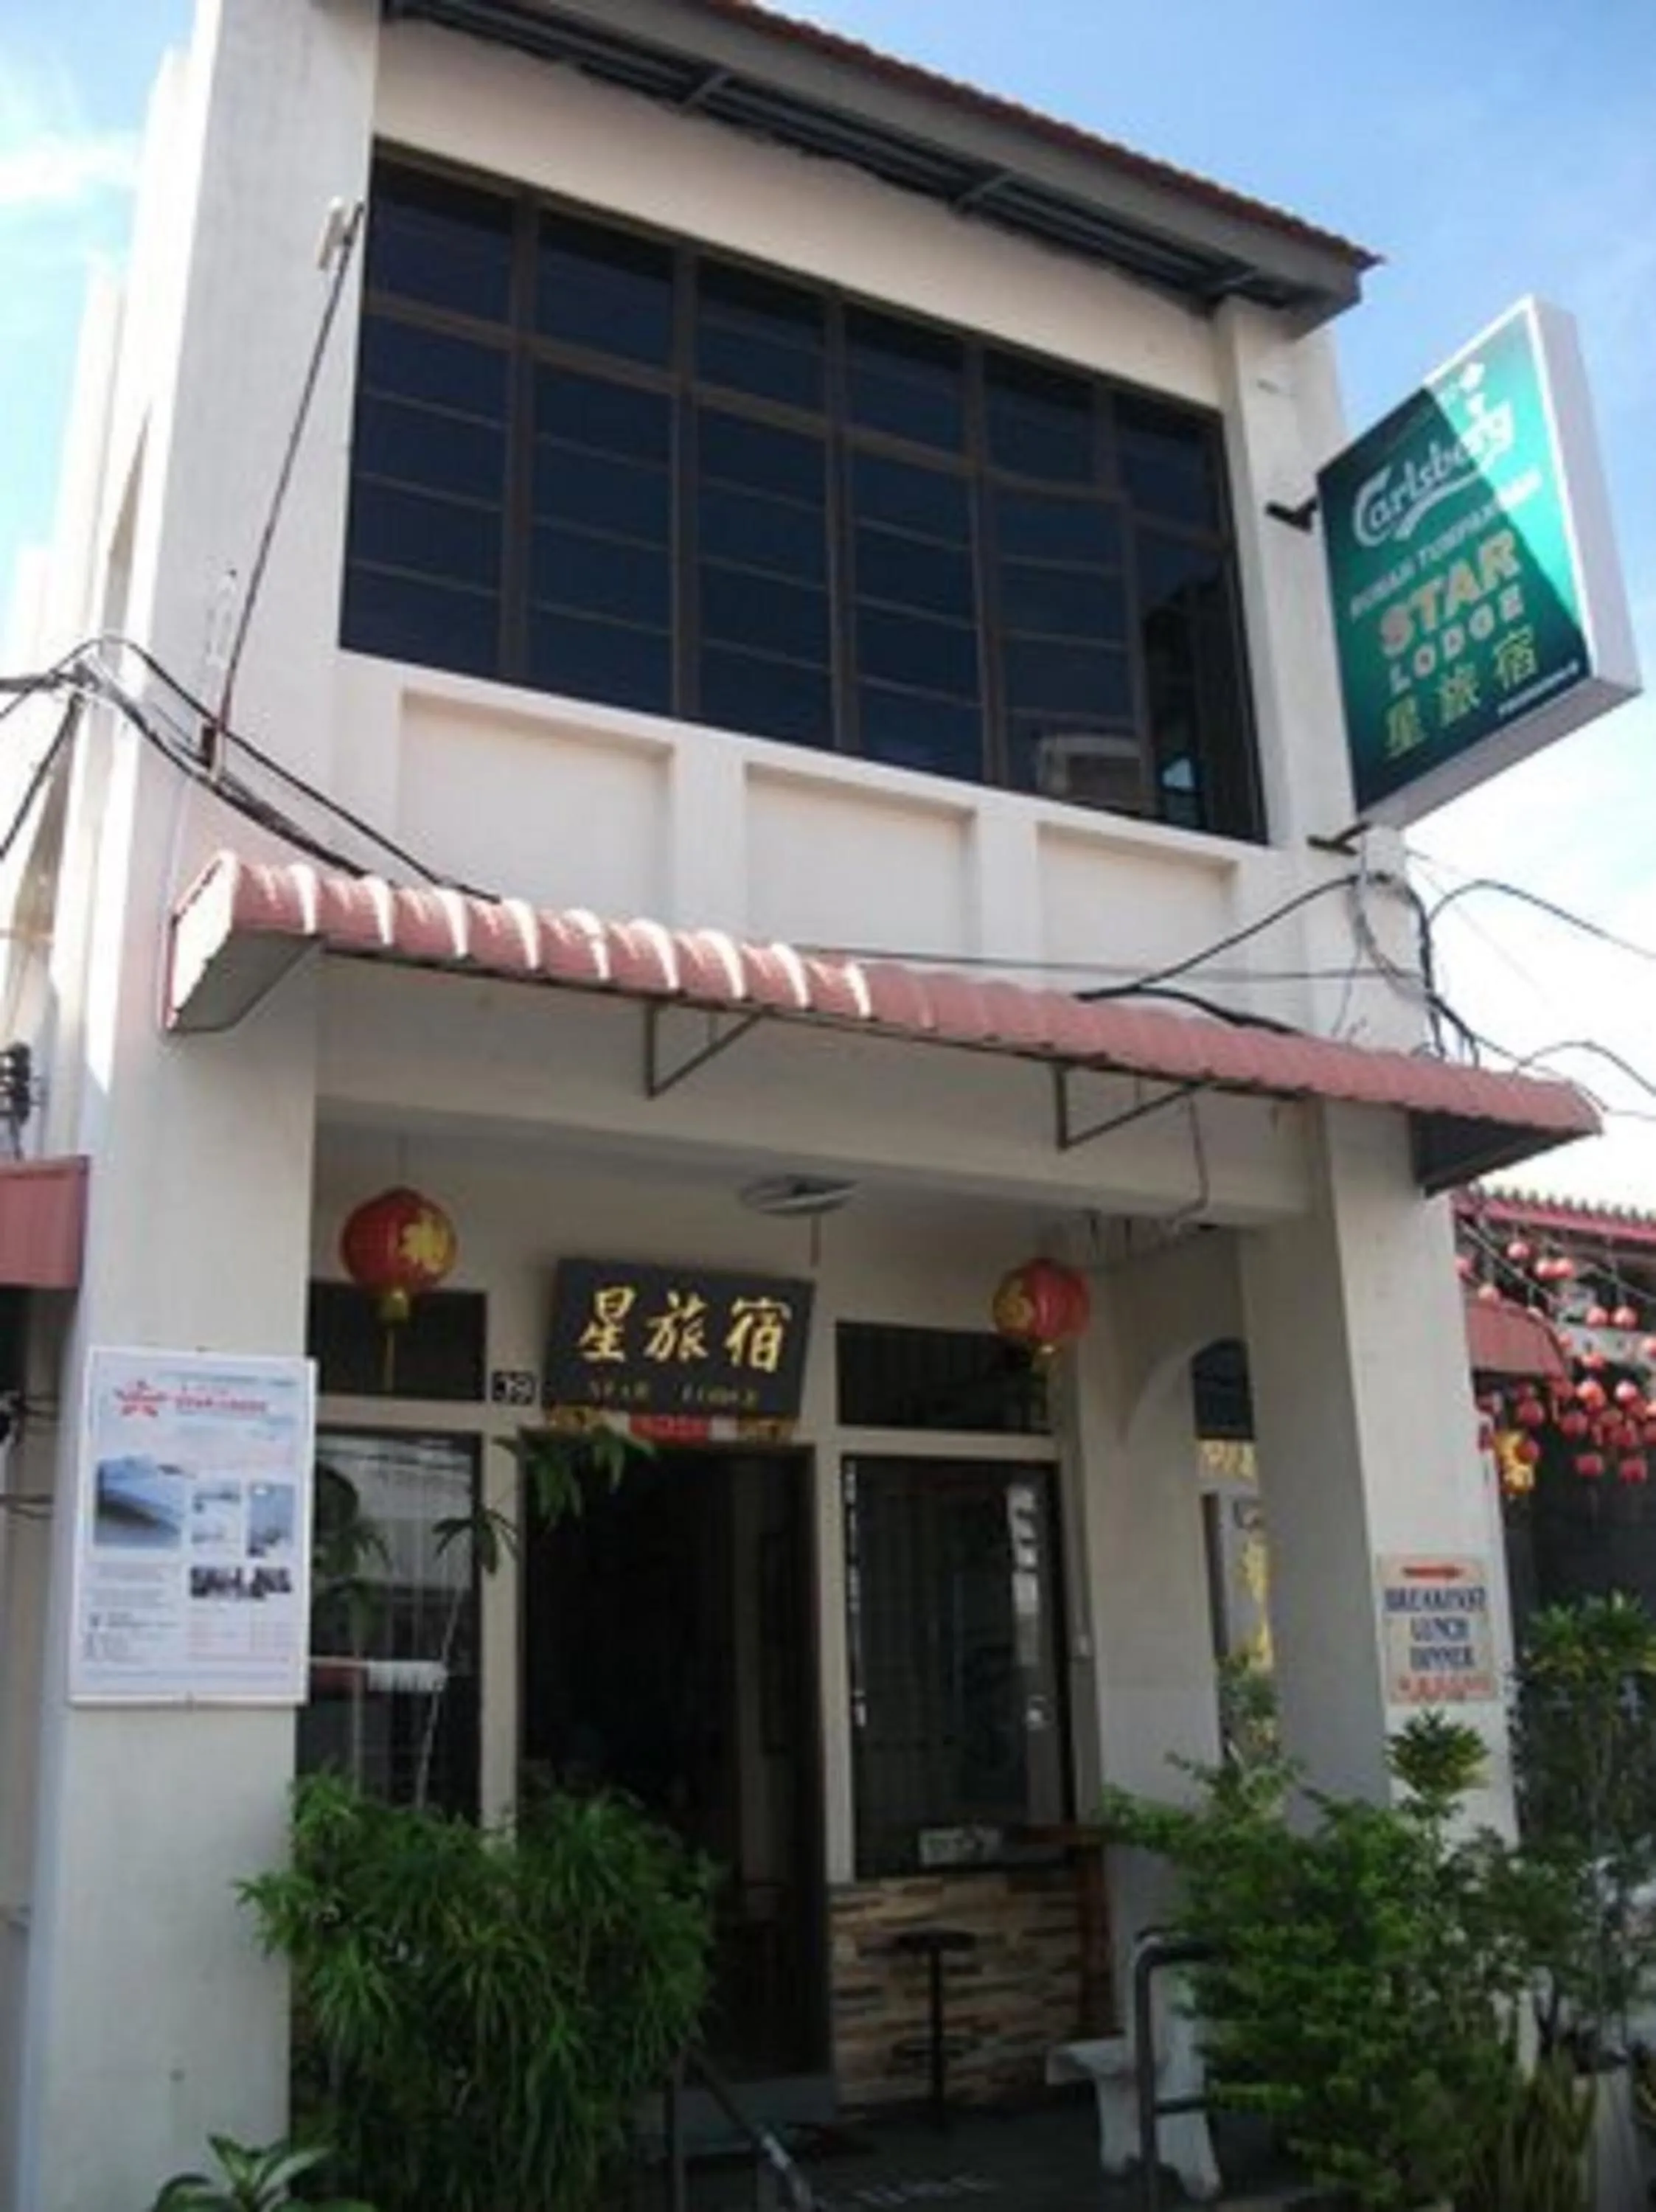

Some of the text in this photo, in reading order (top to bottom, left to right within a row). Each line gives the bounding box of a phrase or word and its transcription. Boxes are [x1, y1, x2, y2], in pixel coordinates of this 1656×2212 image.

[1380, 528, 1521, 658] STAR
[1389, 583, 1525, 697] LODGE
[577, 1285, 793, 1373] 星旅宿
